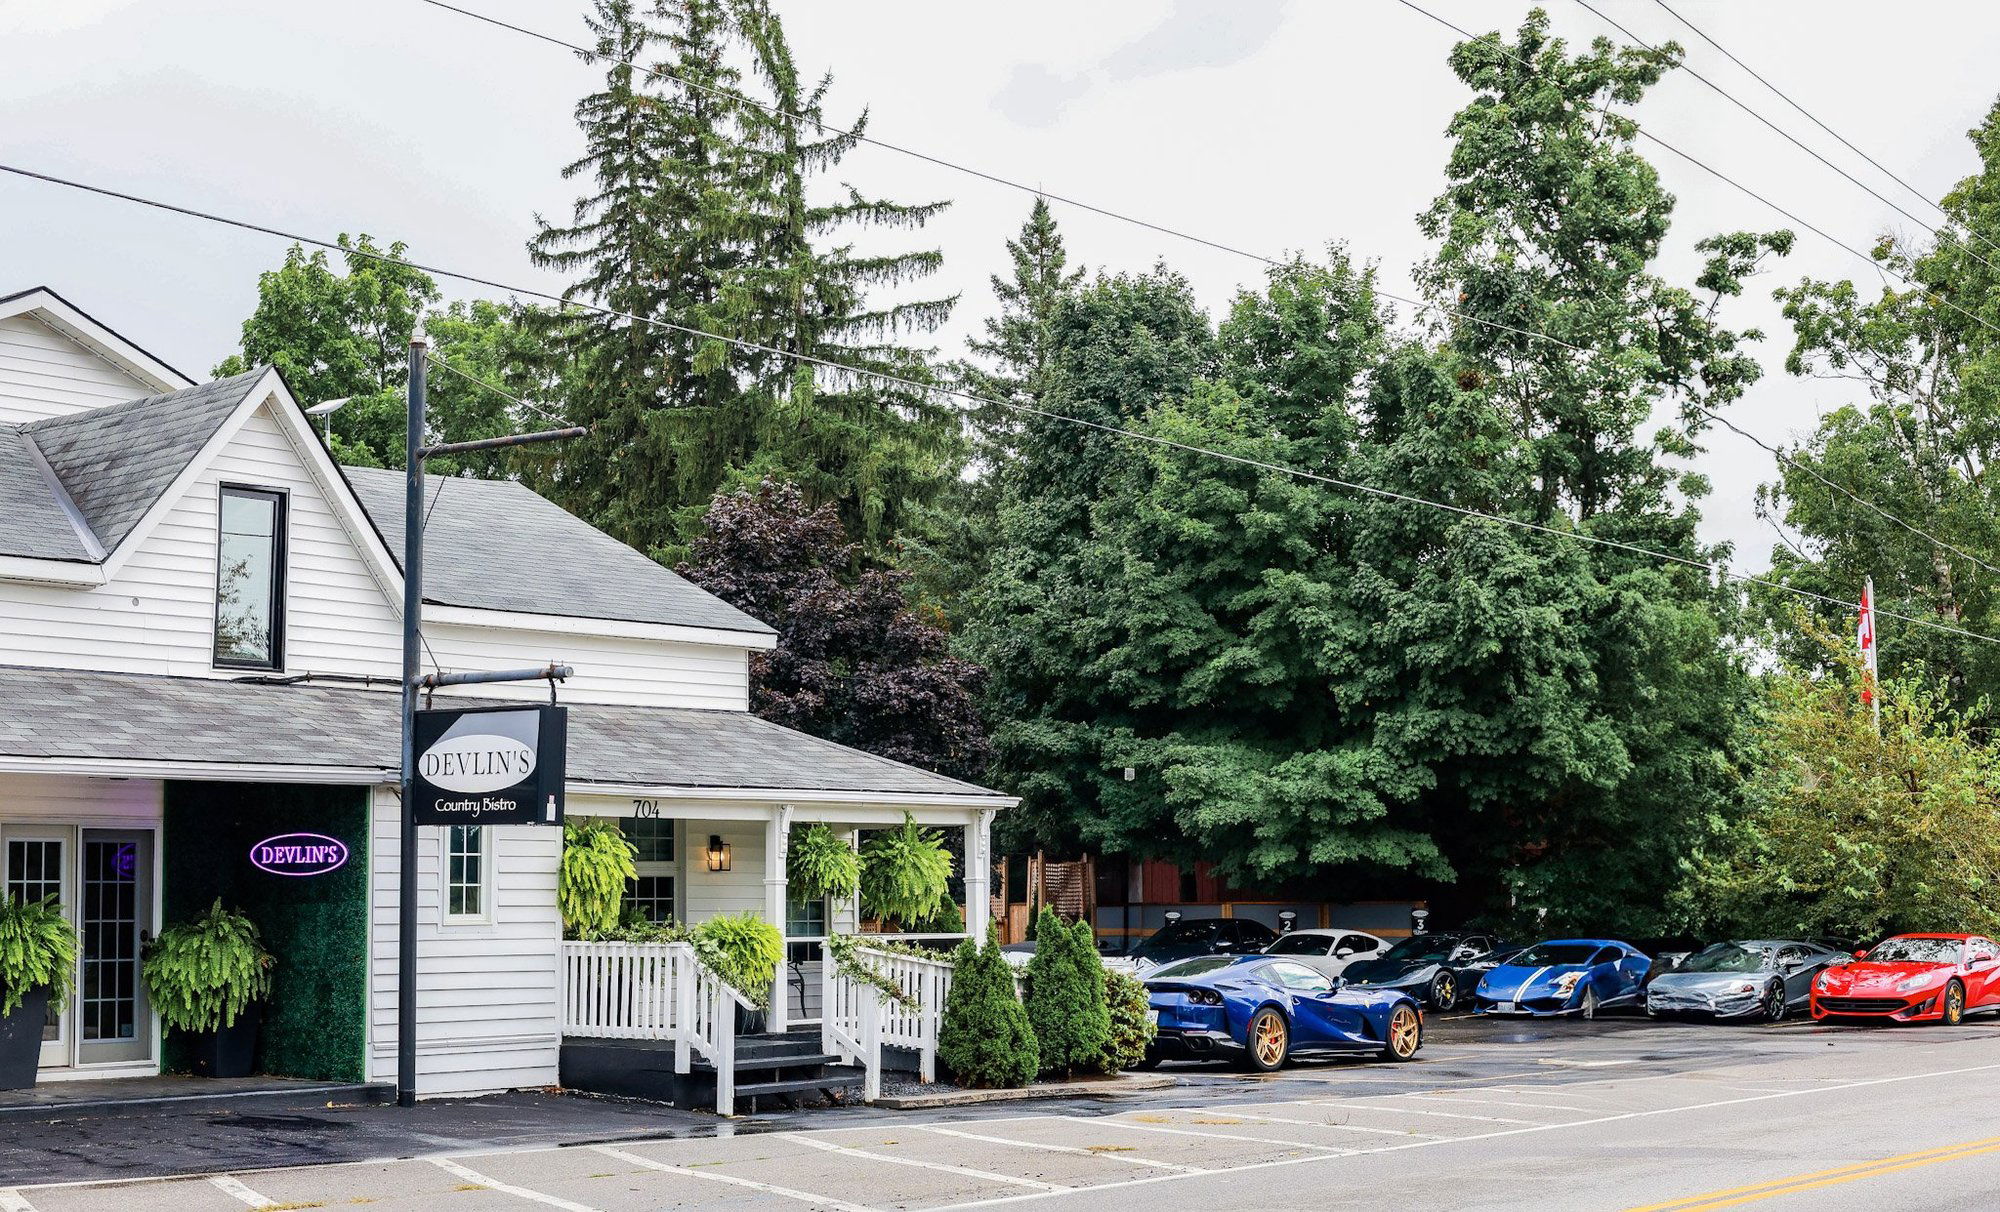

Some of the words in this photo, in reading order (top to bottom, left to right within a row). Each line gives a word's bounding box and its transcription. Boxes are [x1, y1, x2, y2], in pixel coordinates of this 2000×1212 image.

[425, 749, 530, 777] DEVLIN'S
[434, 798, 481, 818] Country
[482, 796, 517, 811] Bistro
[633, 799, 660, 819] 704
[261, 845, 338, 864] DEVLIN'S
[1284, 920, 1291, 931] 2
[1417, 919, 1425, 930] 3
